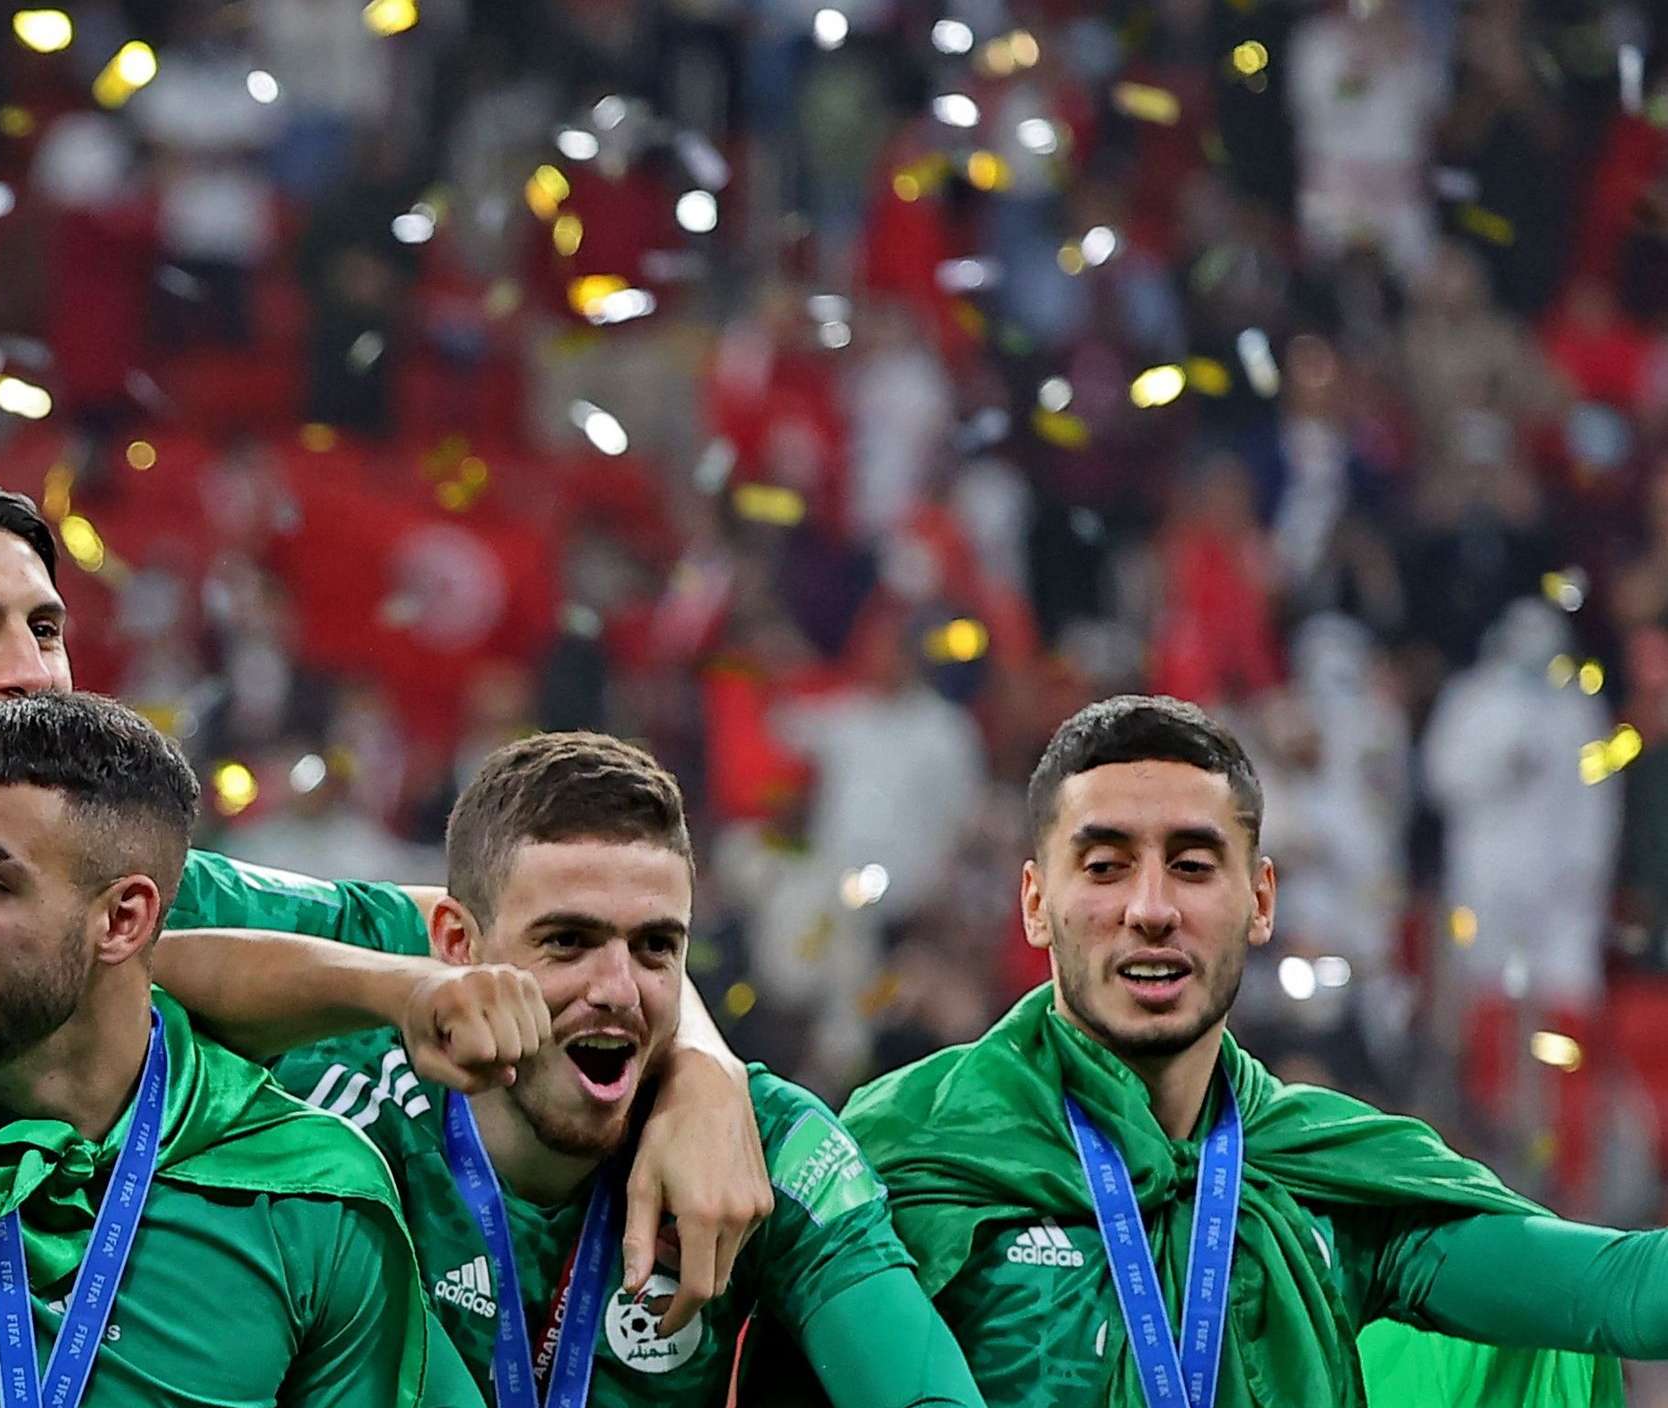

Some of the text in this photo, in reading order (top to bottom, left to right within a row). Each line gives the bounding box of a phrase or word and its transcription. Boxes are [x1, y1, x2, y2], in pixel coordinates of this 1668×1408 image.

[136, 1123, 151, 1156] FIFA
[120, 1172, 137, 1207] FIFA
[103, 1223, 121, 1257] FIFA
[1007, 1246, 1084, 1267] adidas
[0, 1260, 15, 1295] FIFA
[86, 1274, 105, 1308] FIFA
[435, 1281, 497, 1318] adidas
[7, 1314, 21, 1348] FIFA
[69, 1324, 88, 1359] FIFA
[13, 1367, 28, 1402] FIFA
[52, 1375, 71, 1408] FIFA
